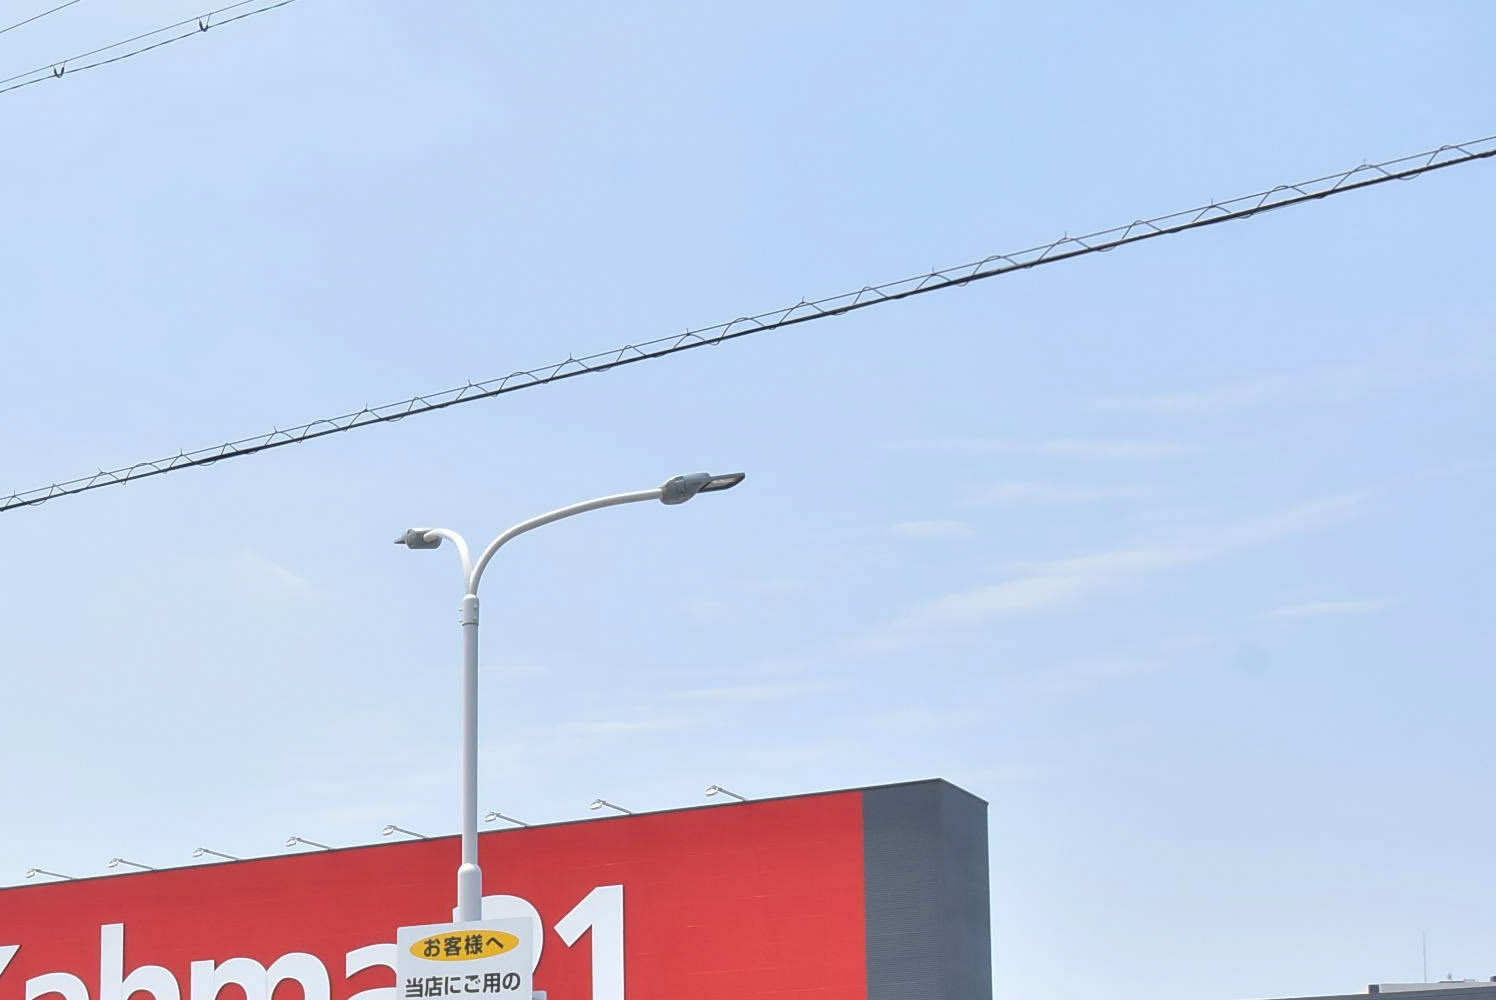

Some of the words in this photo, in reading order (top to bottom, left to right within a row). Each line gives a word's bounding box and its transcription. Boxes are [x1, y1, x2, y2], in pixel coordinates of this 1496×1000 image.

[423, 933, 505, 958] お客様へ
[405, 971, 521, 999] 当店にご用の
